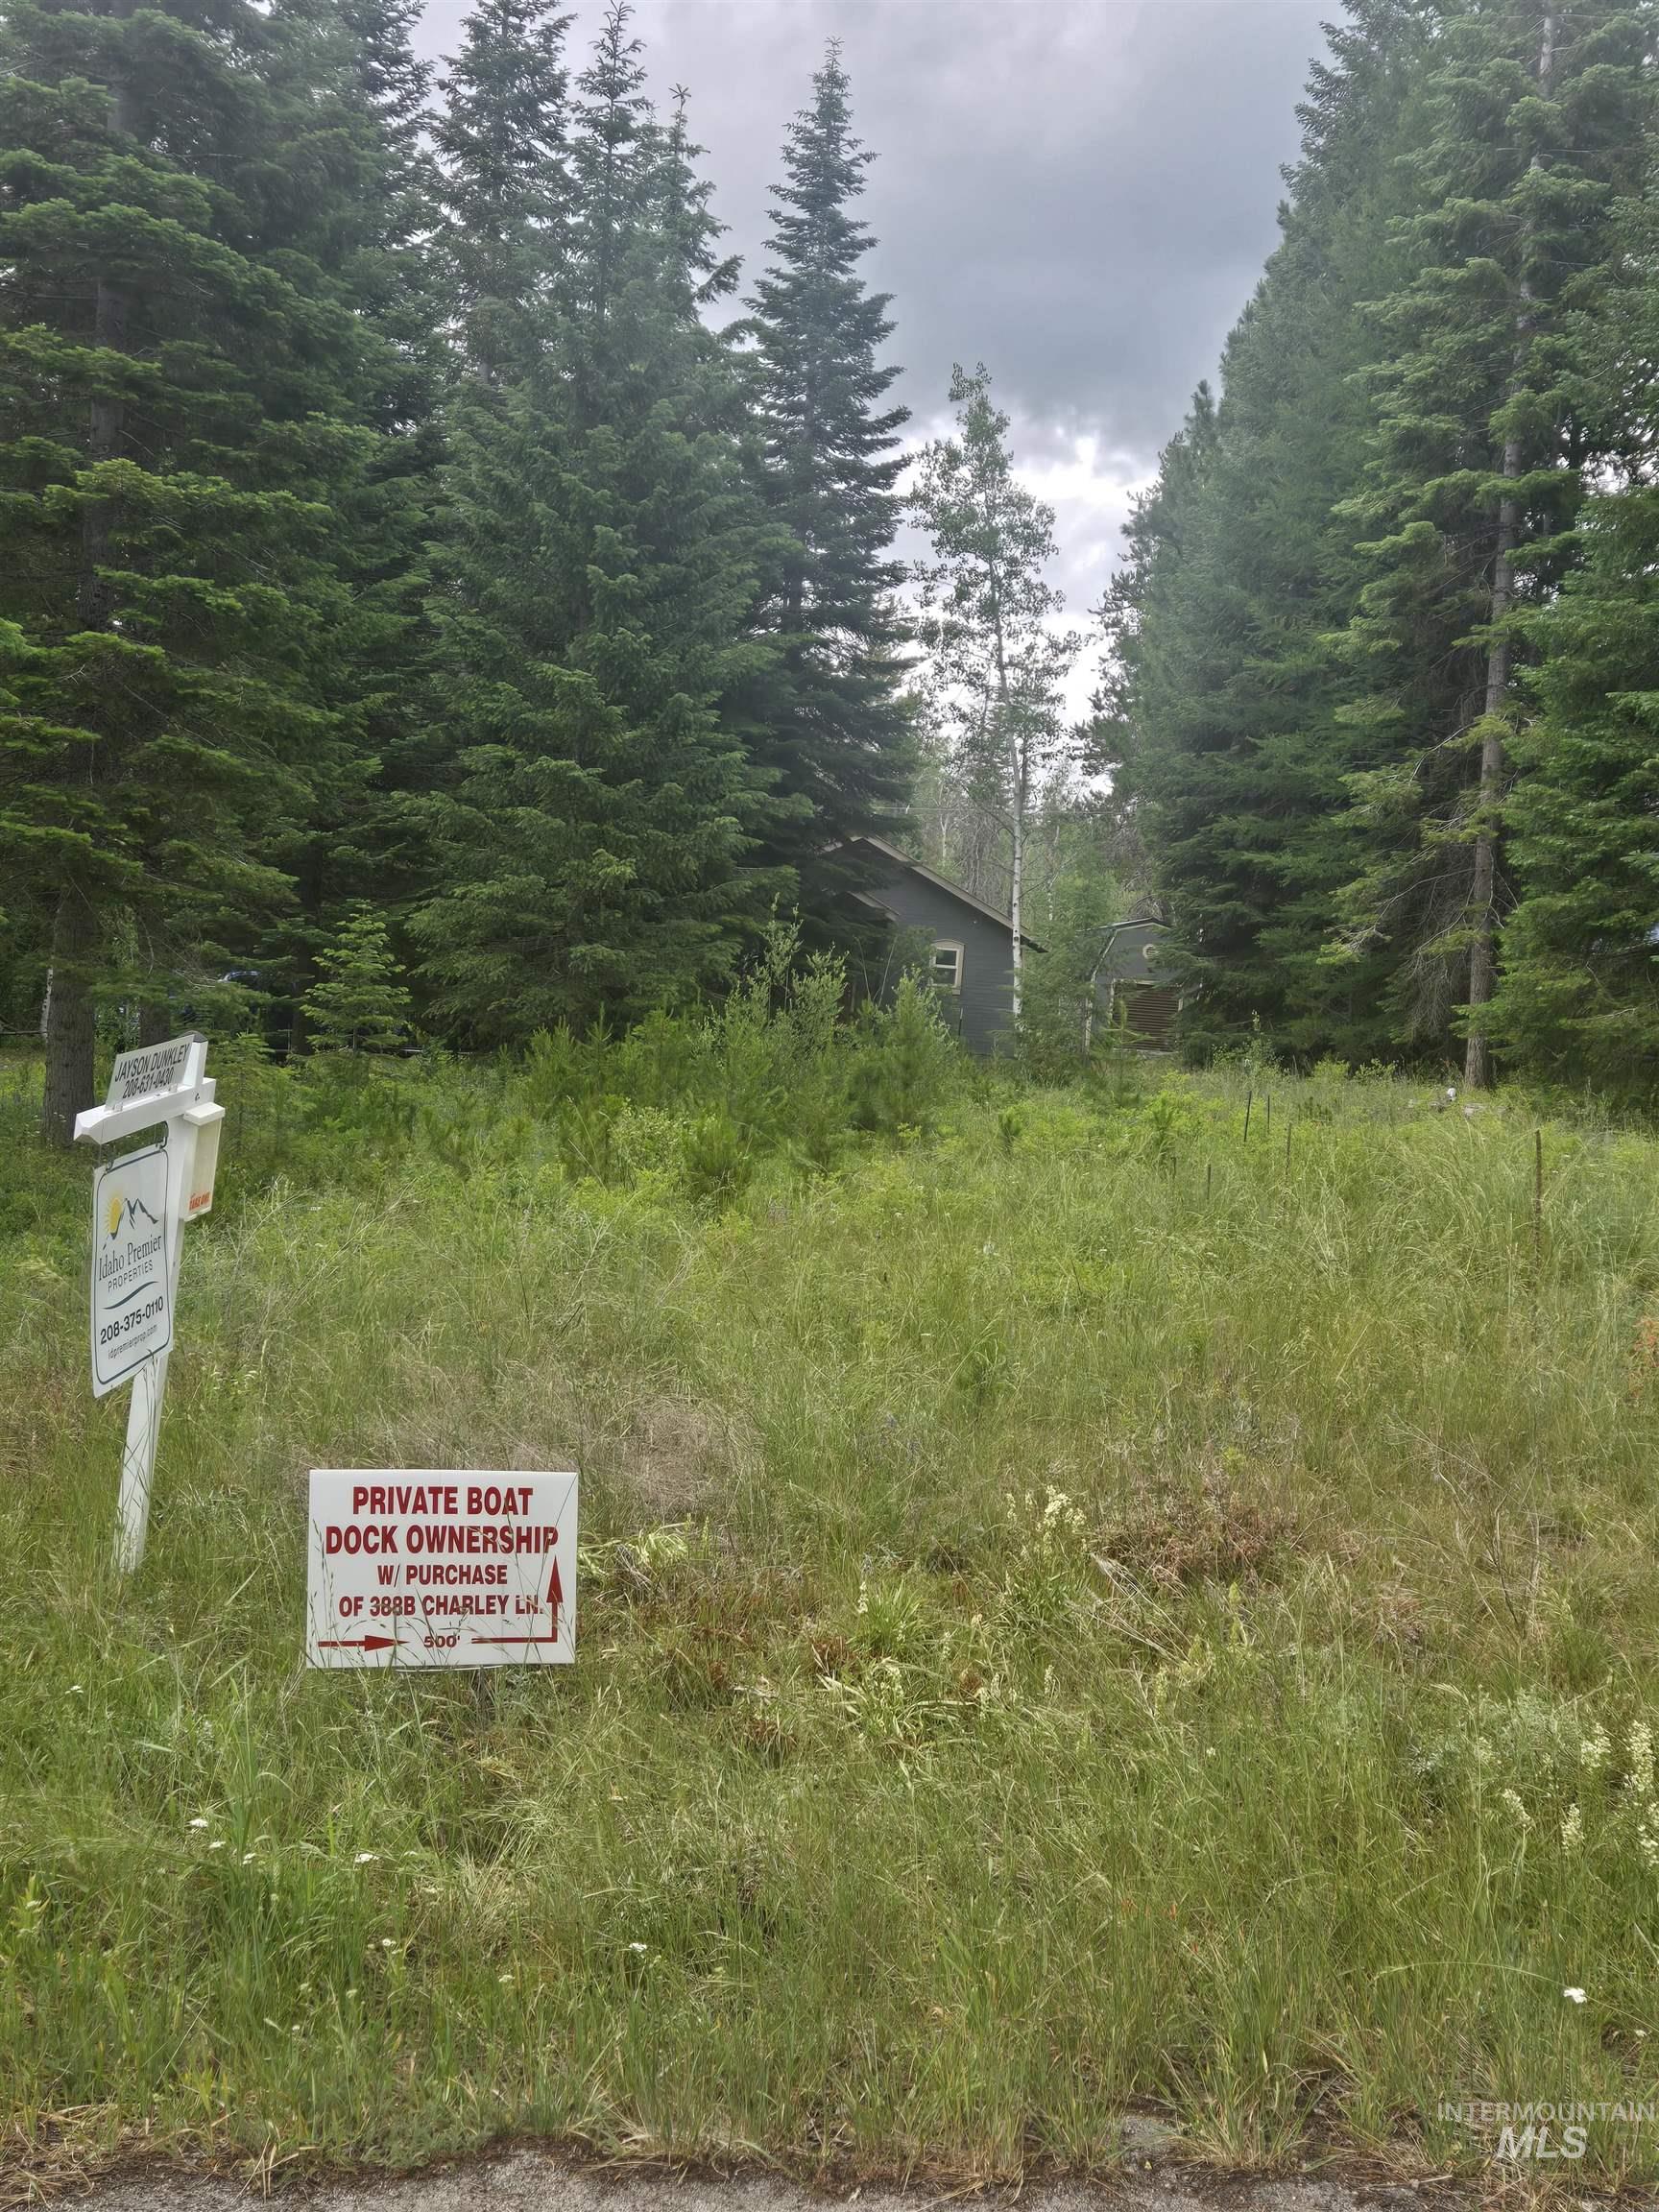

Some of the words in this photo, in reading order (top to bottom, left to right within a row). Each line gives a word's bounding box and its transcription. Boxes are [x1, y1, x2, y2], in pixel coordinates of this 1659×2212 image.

[114, 1056, 151, 1082] JAYSON
[150, 1043, 190, 1071] DUNKLEY
[122, 1066, 175, 1099] 208-631-0430
[99, 1249, 125, 1282] Idaho
[127, 1234, 161, 1265] Premier
[108, 1259, 154, 1293] PROPERTIES
[100, 1296, 163, 1345] 208-375-0110
[352, 1486, 459, 1515] PRIVATE
[467, 1487, 534, 1516] BOAT
[325, 1525, 399, 1554] DOCK
[406, 1525, 560, 1554] OWNERSHIP
[377, 1564, 401, 1588] W/
[406, 1564, 508, 1585] PURCHASE
[338, 1596, 364, 1617] OF
[369, 1596, 416, 1617] 388B
[422, 1595, 510, 1616] CHARLEY
